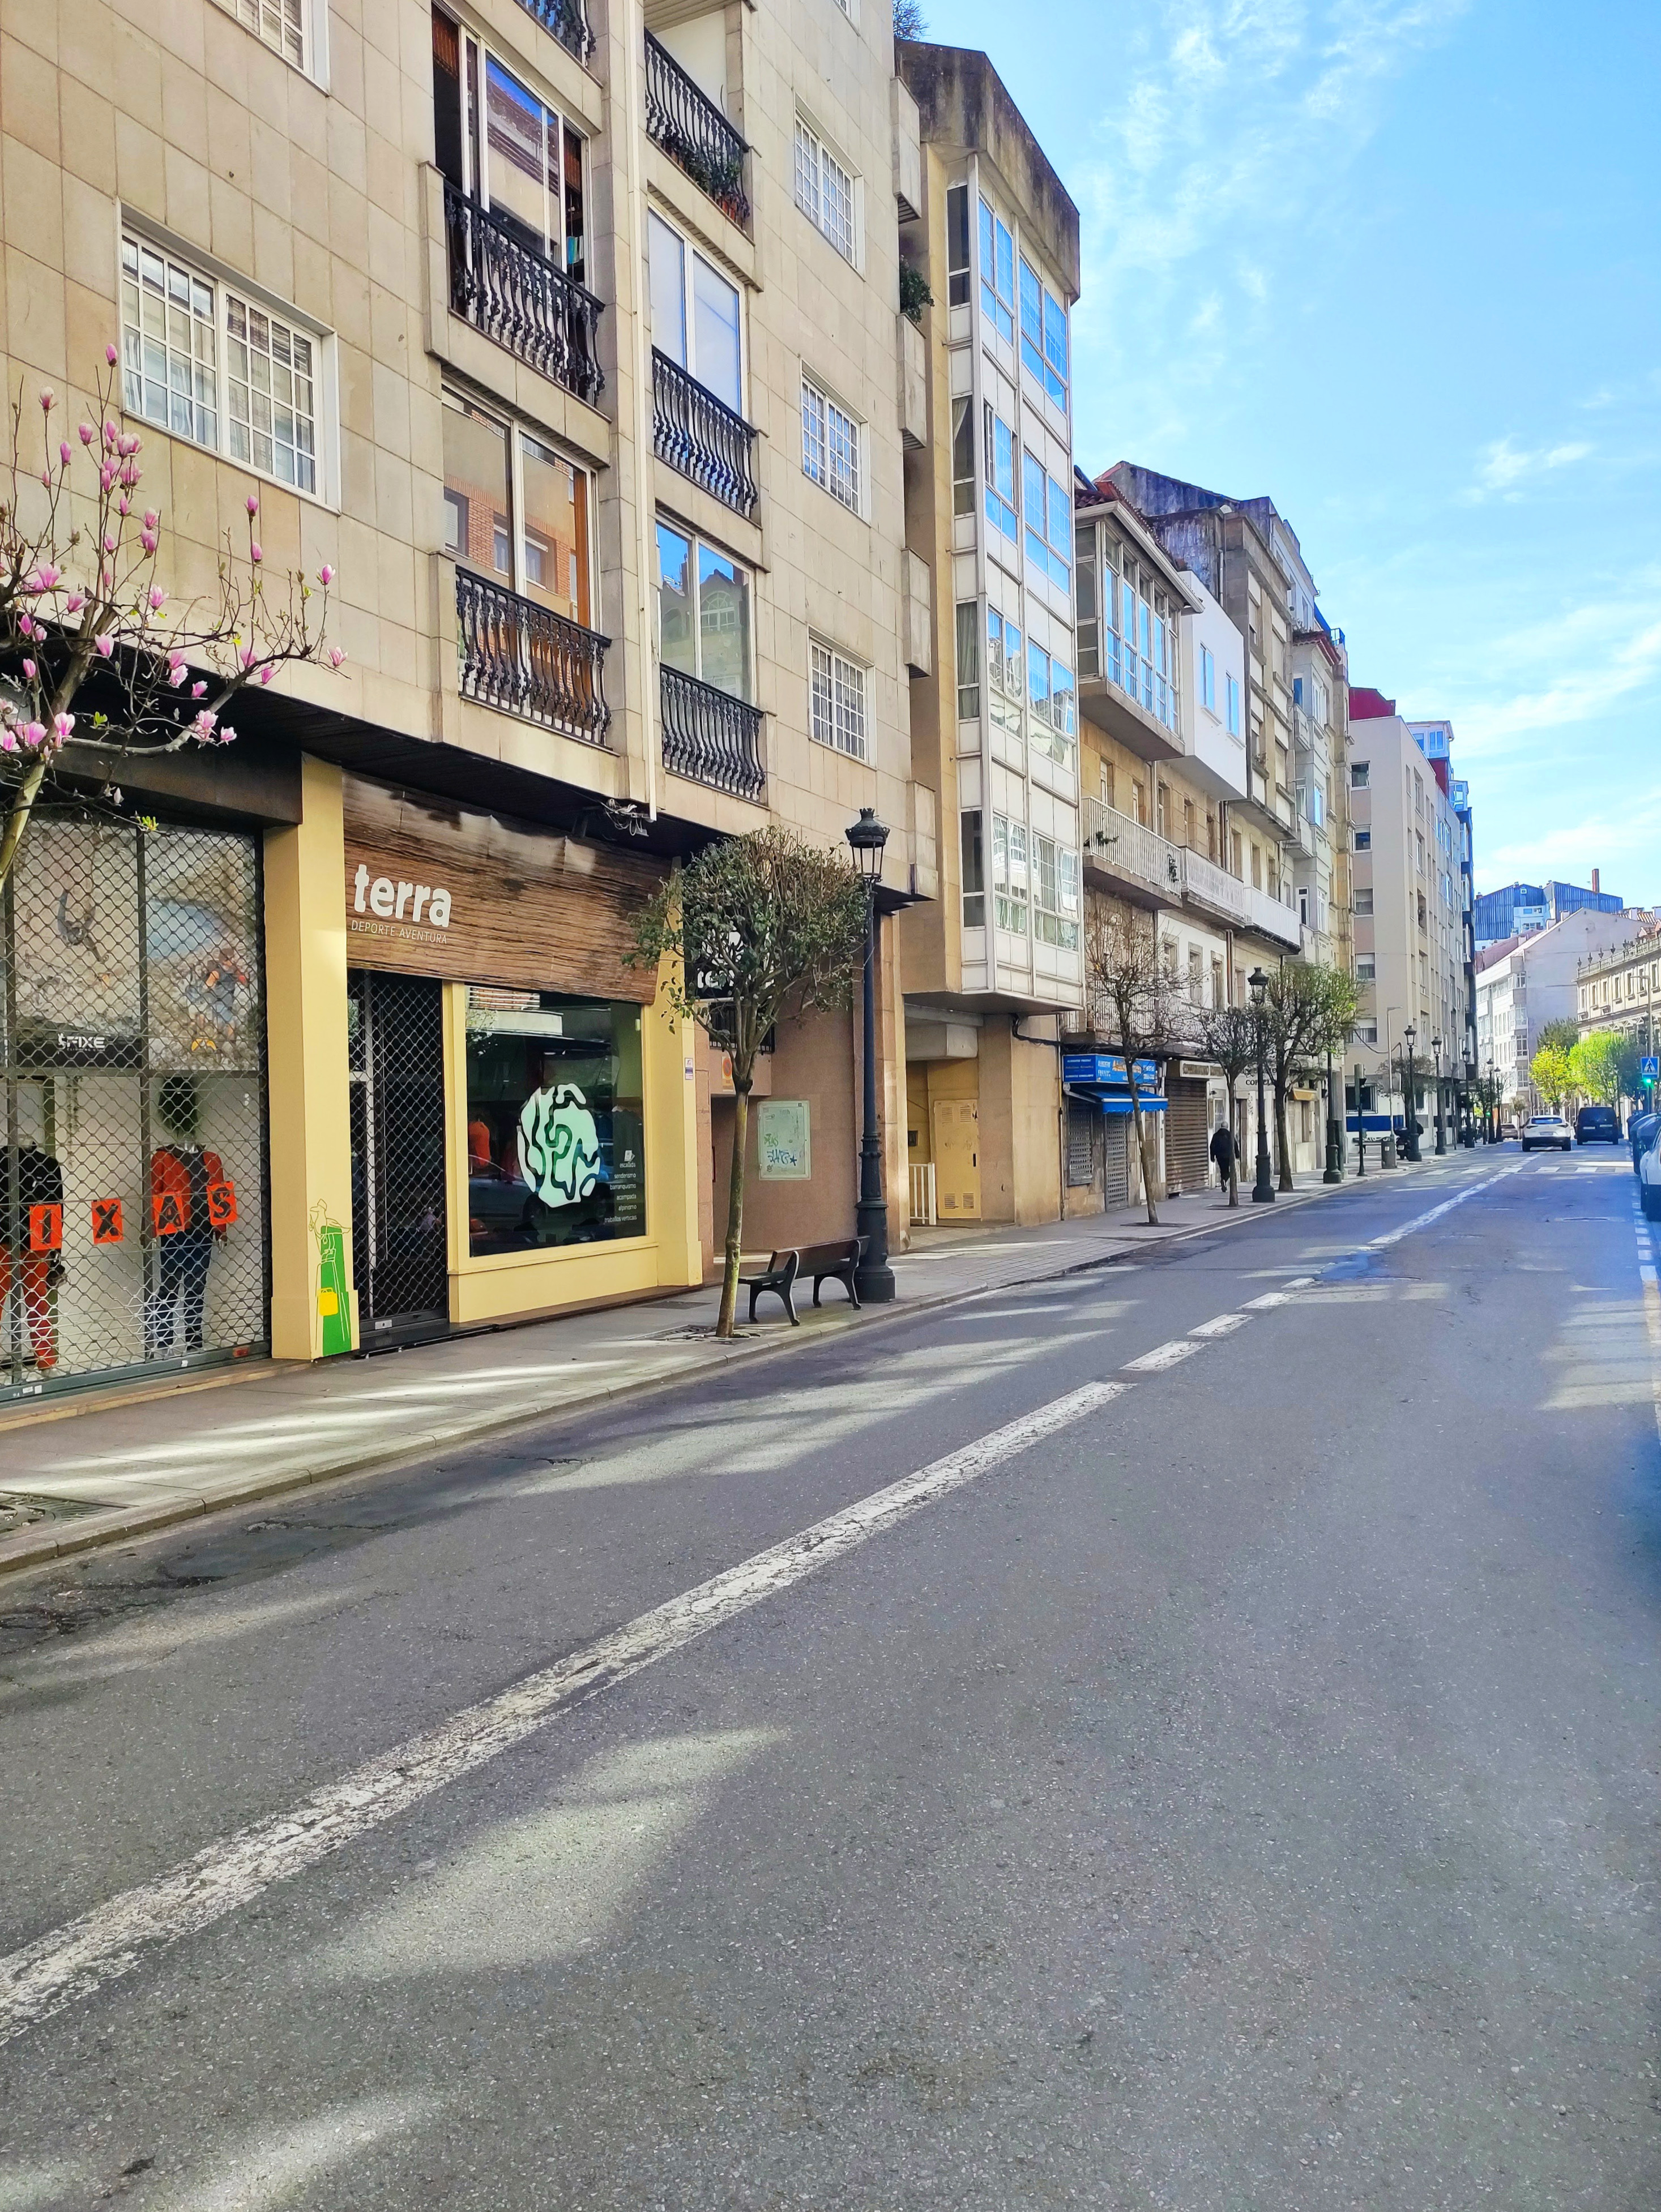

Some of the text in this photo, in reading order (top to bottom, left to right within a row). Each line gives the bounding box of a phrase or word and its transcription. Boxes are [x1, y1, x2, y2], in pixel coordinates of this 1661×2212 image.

[354, 864, 451, 928] terra
[351, 920, 447, 944] DEPORTE AVENTURA
